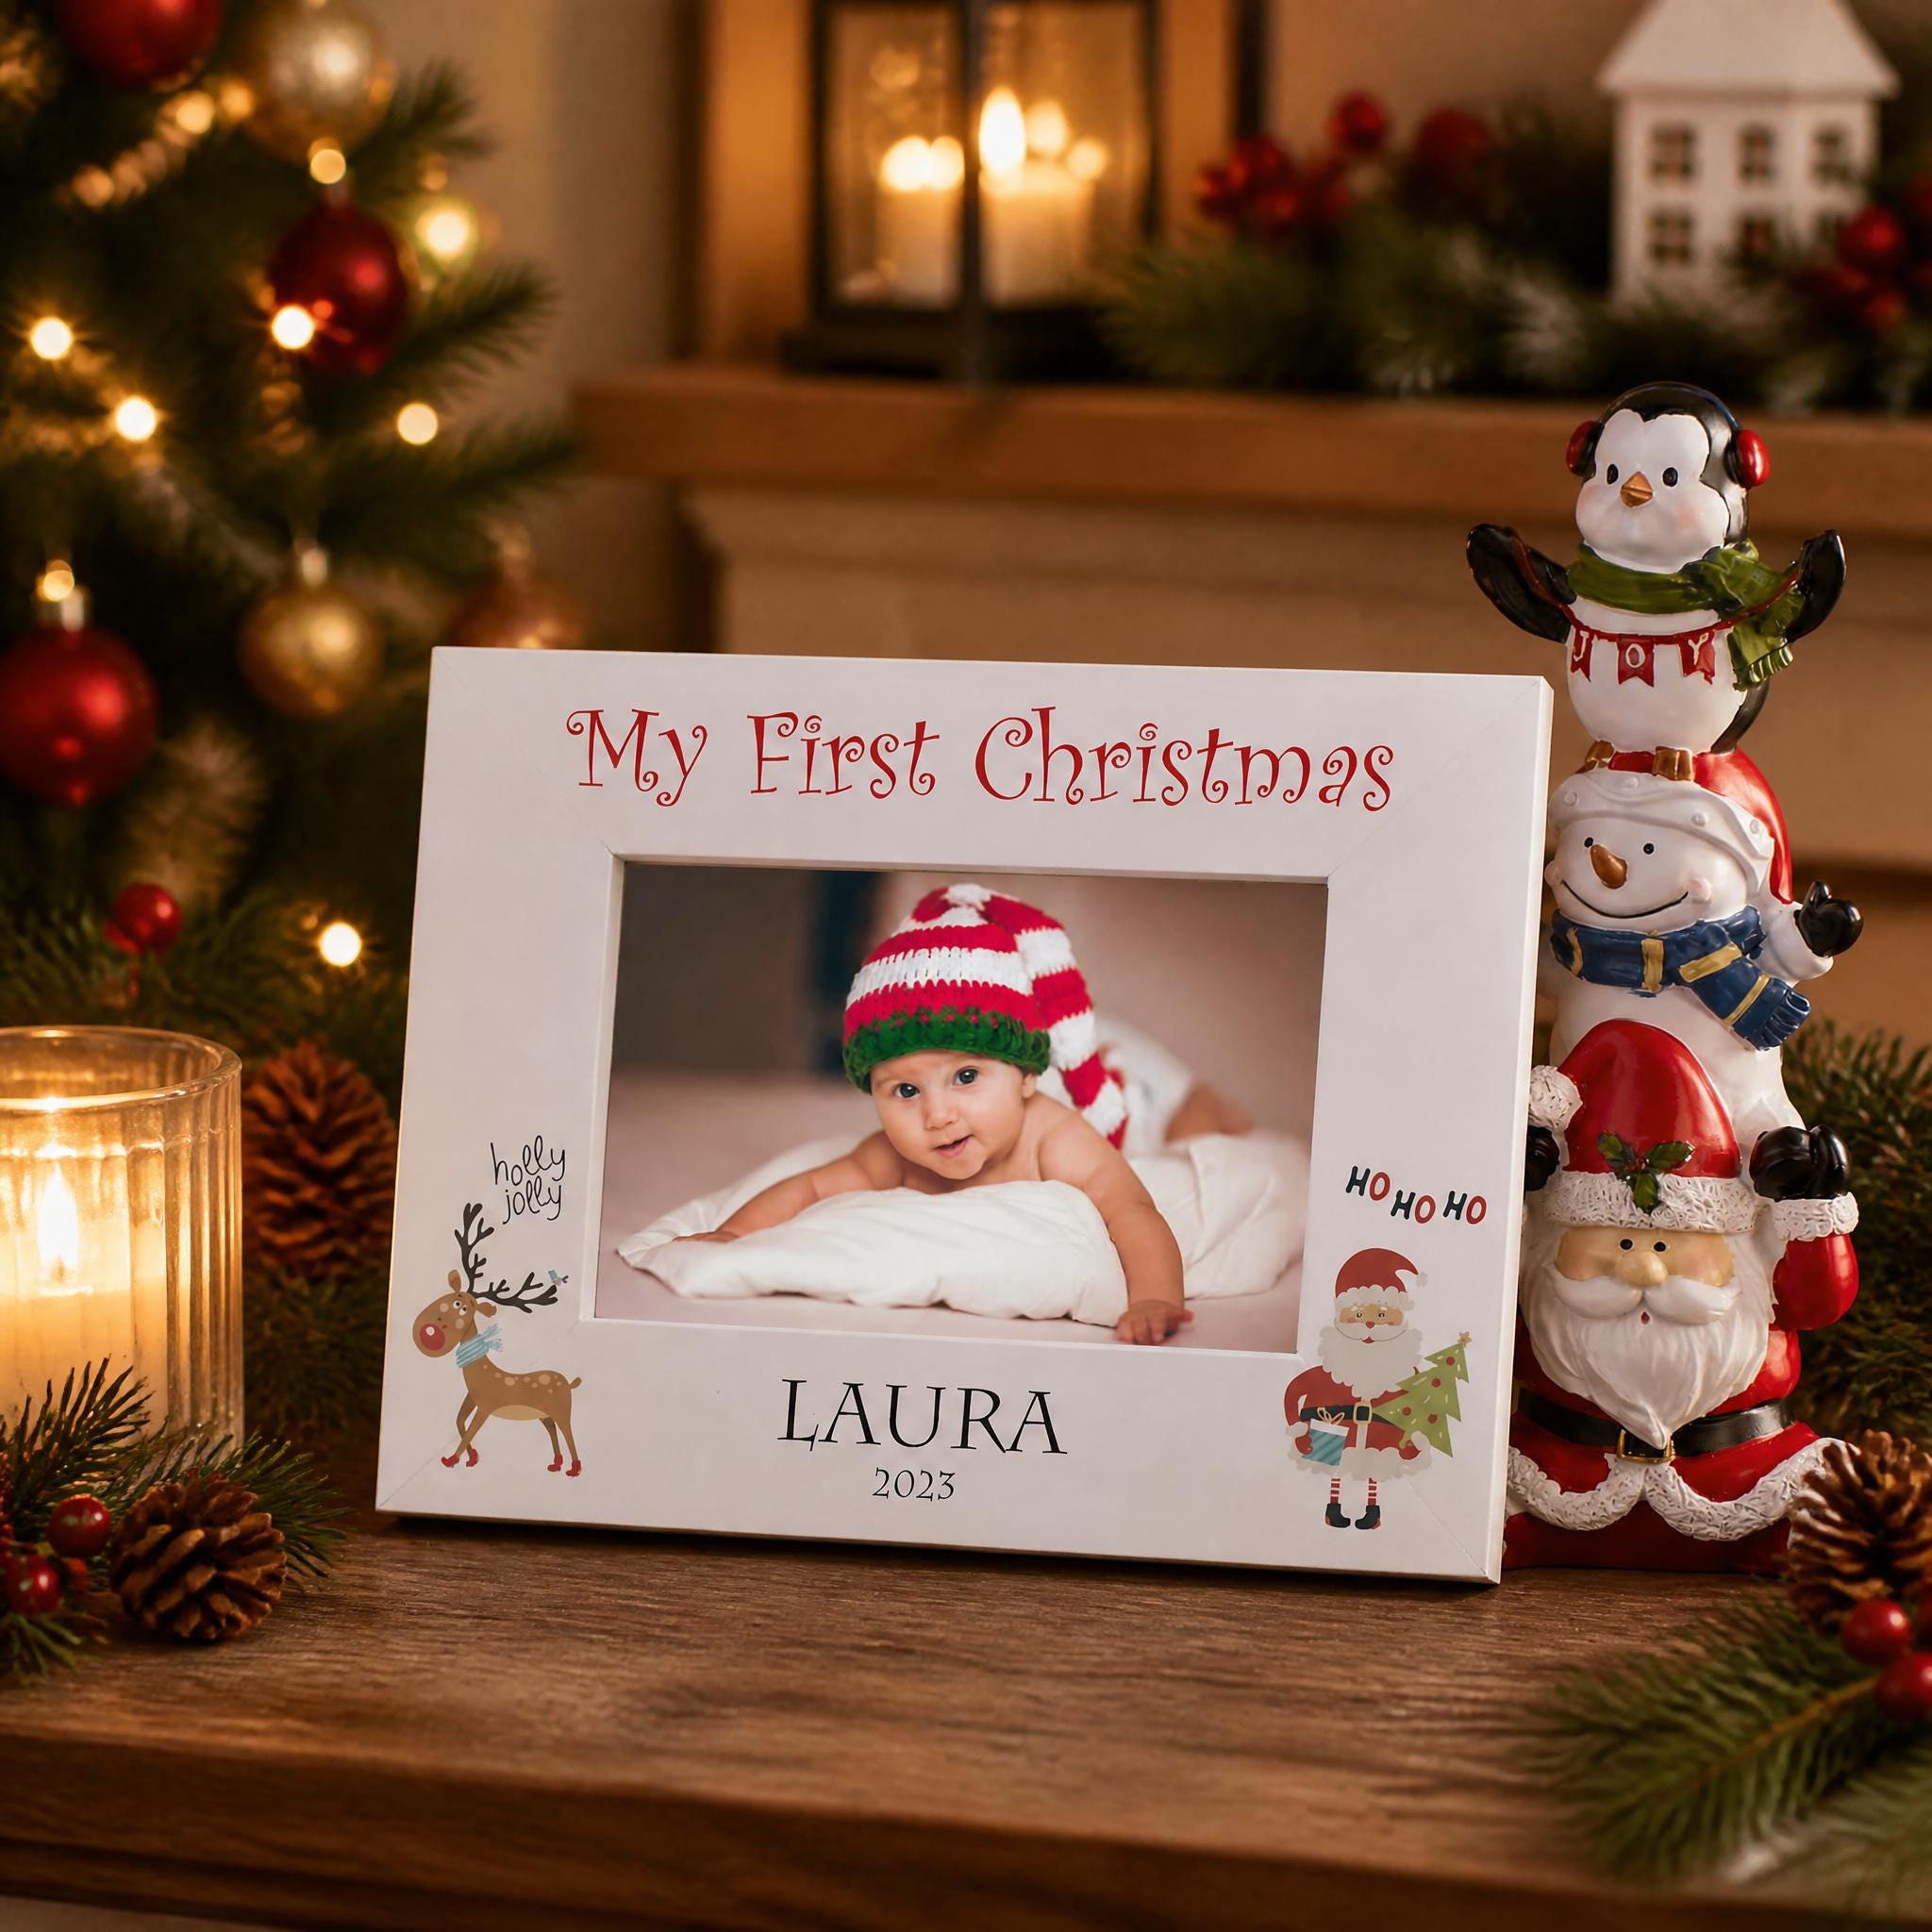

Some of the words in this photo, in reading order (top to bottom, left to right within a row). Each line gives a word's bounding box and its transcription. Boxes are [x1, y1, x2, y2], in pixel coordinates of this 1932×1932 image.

[566, 708, 708, 808] My
[747, 711, 941, 799] First
[974, 706, 1395, 812] Christmas
[490, 1135, 565, 1187] holly
[503, 1175, 561, 1224] jolly
[1345, 1165, 1391, 1201] HO
[1391, 1190, 1436, 1224] HO
[1442, 1191, 1487, 1224] HO
[777, 1378, 1068, 1454] LAURA
[872, 1467, 956, 1502] 2023
